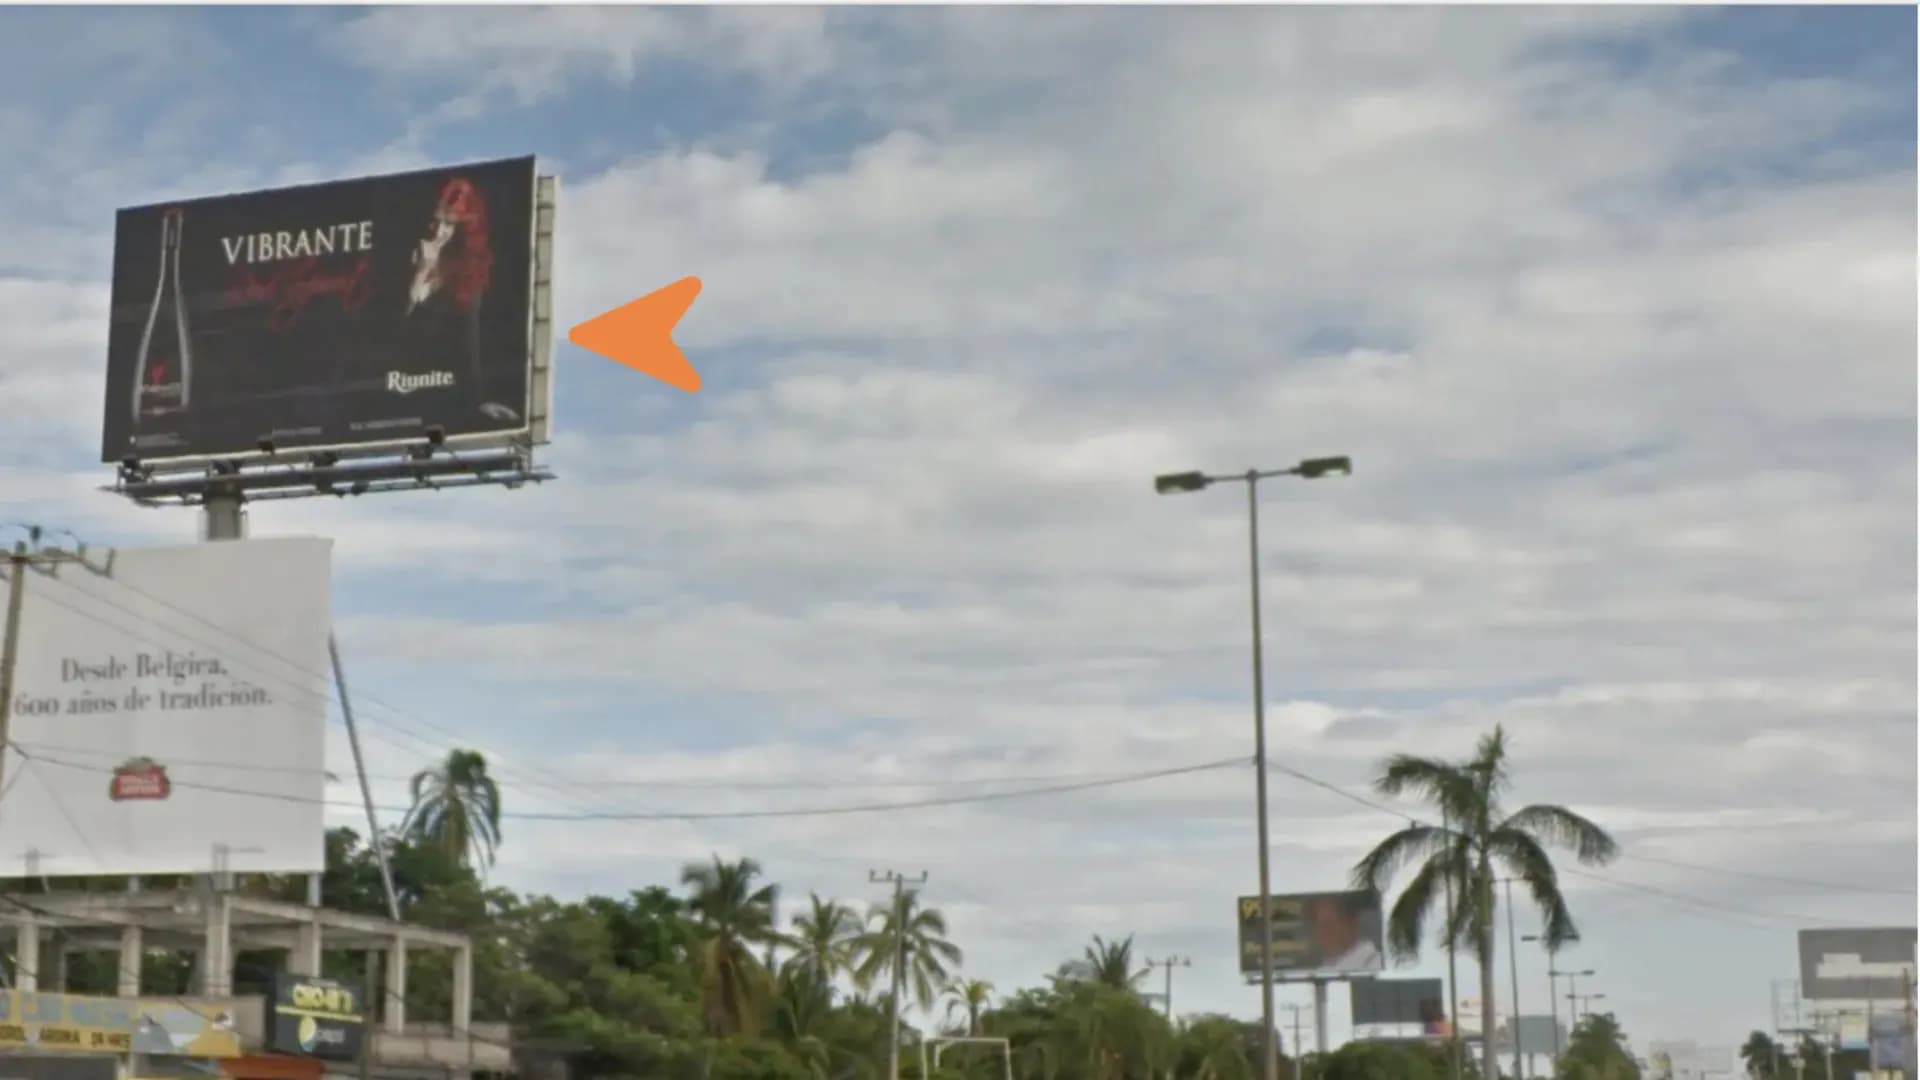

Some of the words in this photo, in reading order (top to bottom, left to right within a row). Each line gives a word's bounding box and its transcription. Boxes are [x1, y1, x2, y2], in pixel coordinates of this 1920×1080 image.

[220, 220, 374, 265] VIBRANTE
[387, 370, 455, 393] Riunite
[61, 656, 129, 683] Desde
[14, 692, 60, 717] 600
[65, 689, 118, 715] años
[123, 686, 151, 711] de
